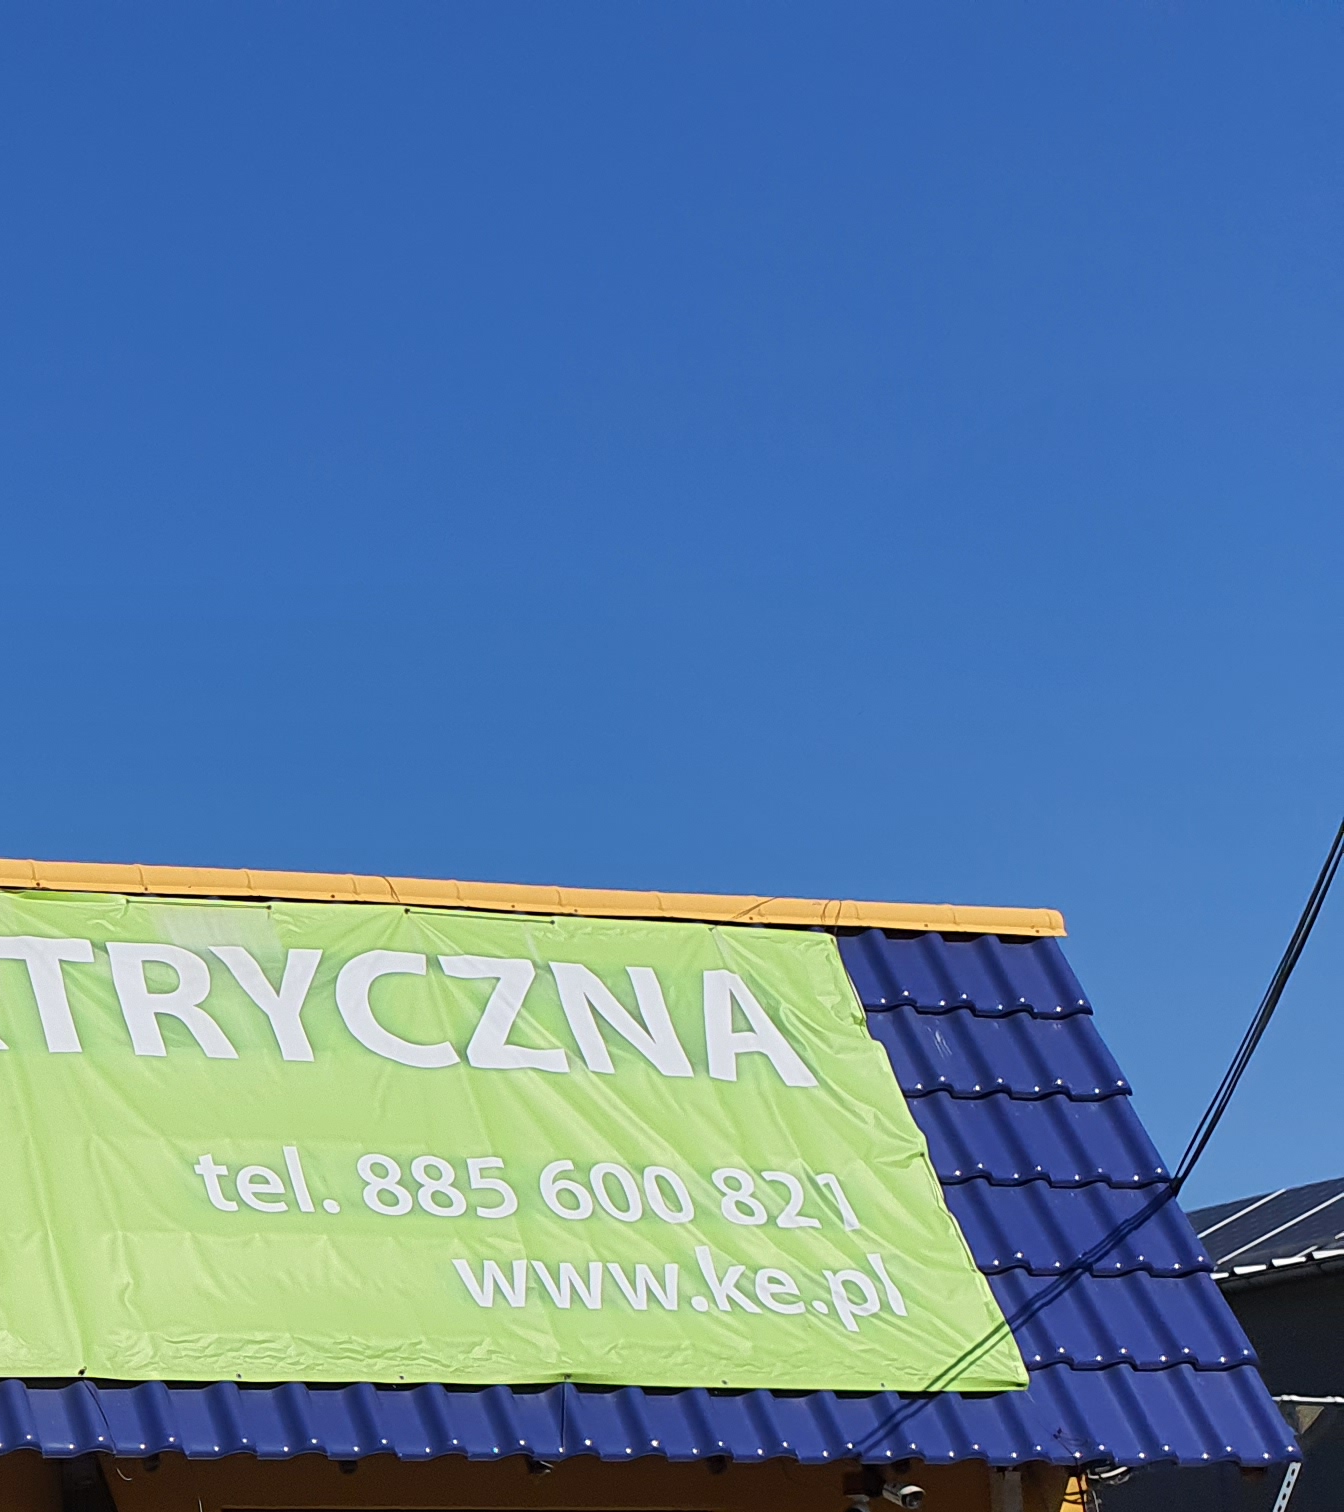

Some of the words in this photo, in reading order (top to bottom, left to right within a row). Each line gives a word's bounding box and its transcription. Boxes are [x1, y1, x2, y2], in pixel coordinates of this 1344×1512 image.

[194, 1145, 341, 1215] tel.
[356, 1153, 515, 1220] 885
[538, 1159, 695, 1225] 600
[711, 1166, 861, 1231] 821
[452, 1246, 908, 1332] www.ke.pl
